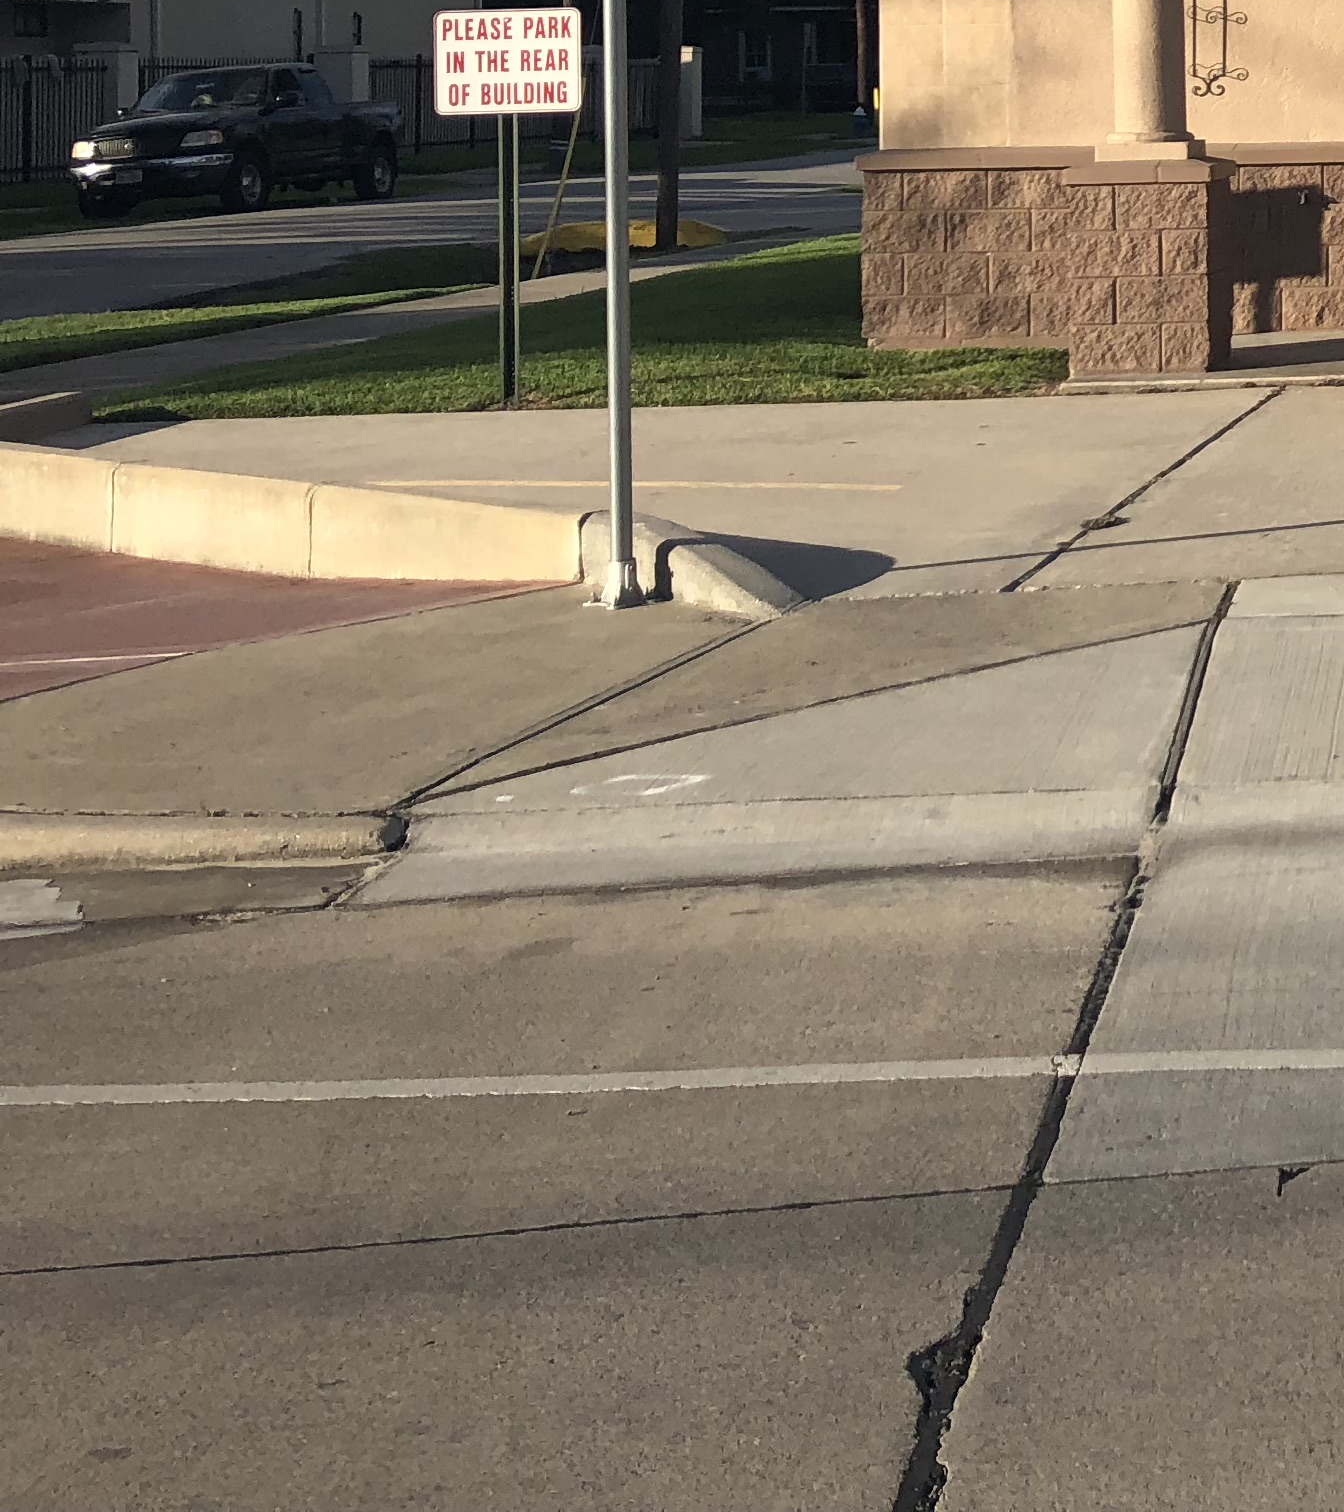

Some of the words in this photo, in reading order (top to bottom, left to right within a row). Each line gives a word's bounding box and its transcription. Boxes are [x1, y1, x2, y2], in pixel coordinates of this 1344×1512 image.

[442, 17, 513, 41] PLEASE
[523, 16, 572, 39] PARK
[446, 51, 465, 74] IN
[475, 50, 510, 73] THE
[520, 48, 569, 72] REAR
[448, 83, 471, 107] OF
[481, 81, 568, 106] BUILDING
